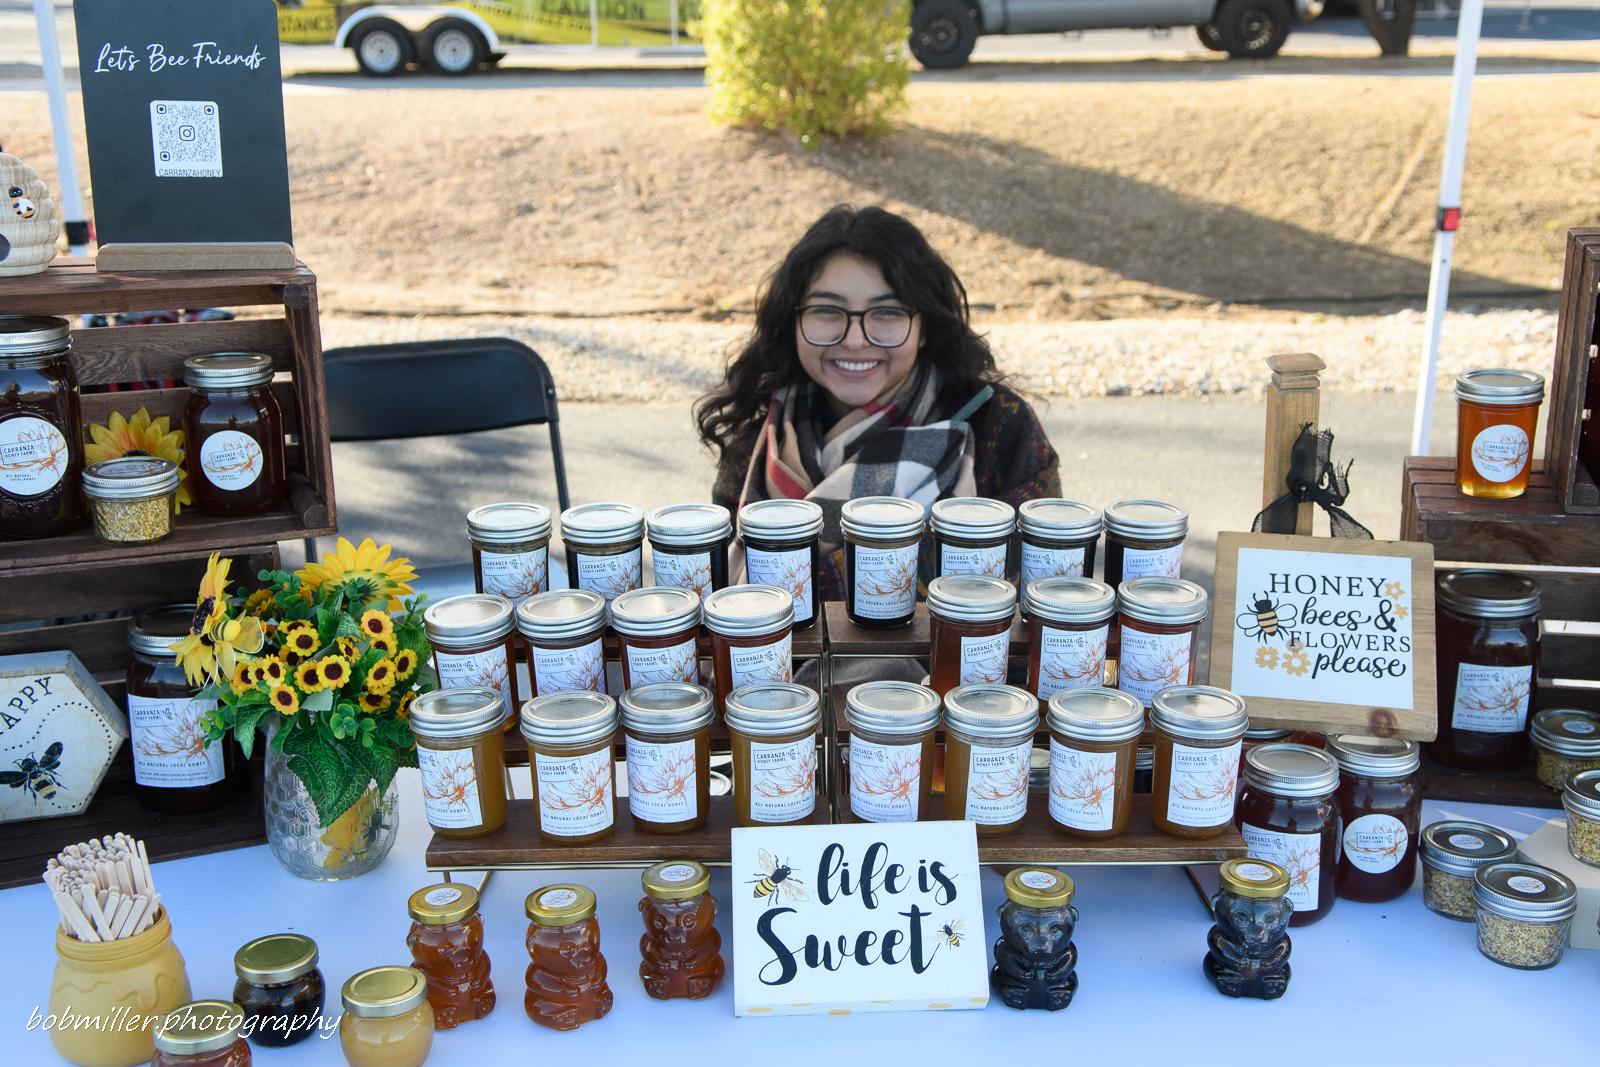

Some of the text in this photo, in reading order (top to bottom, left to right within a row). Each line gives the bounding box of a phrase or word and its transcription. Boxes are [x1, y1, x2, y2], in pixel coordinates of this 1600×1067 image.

[94, 41, 266, 73] Let's Bee Friends
[158, 168, 221, 177] CARRANZAHONEY
[3, 444, 35, 454] CARRANZA
[1269, 573, 1387, 598] HONEY
[1301, 596, 1397, 633] bees &
[966, 643, 993, 653] CARRANZA
[1289, 630, 1411, 653] FLOWERS
[736, 654, 763, 662] CARRANZA
[1311, 645, 1407, 680] please
[0, 676, 52, 735] APPY
[756, 751, 785, 760] CARRANZA
[1245, 834, 1271, 843] CARRANZA
[817, 842, 959, 910] life is
[756, 903, 941, 985] Sweet
